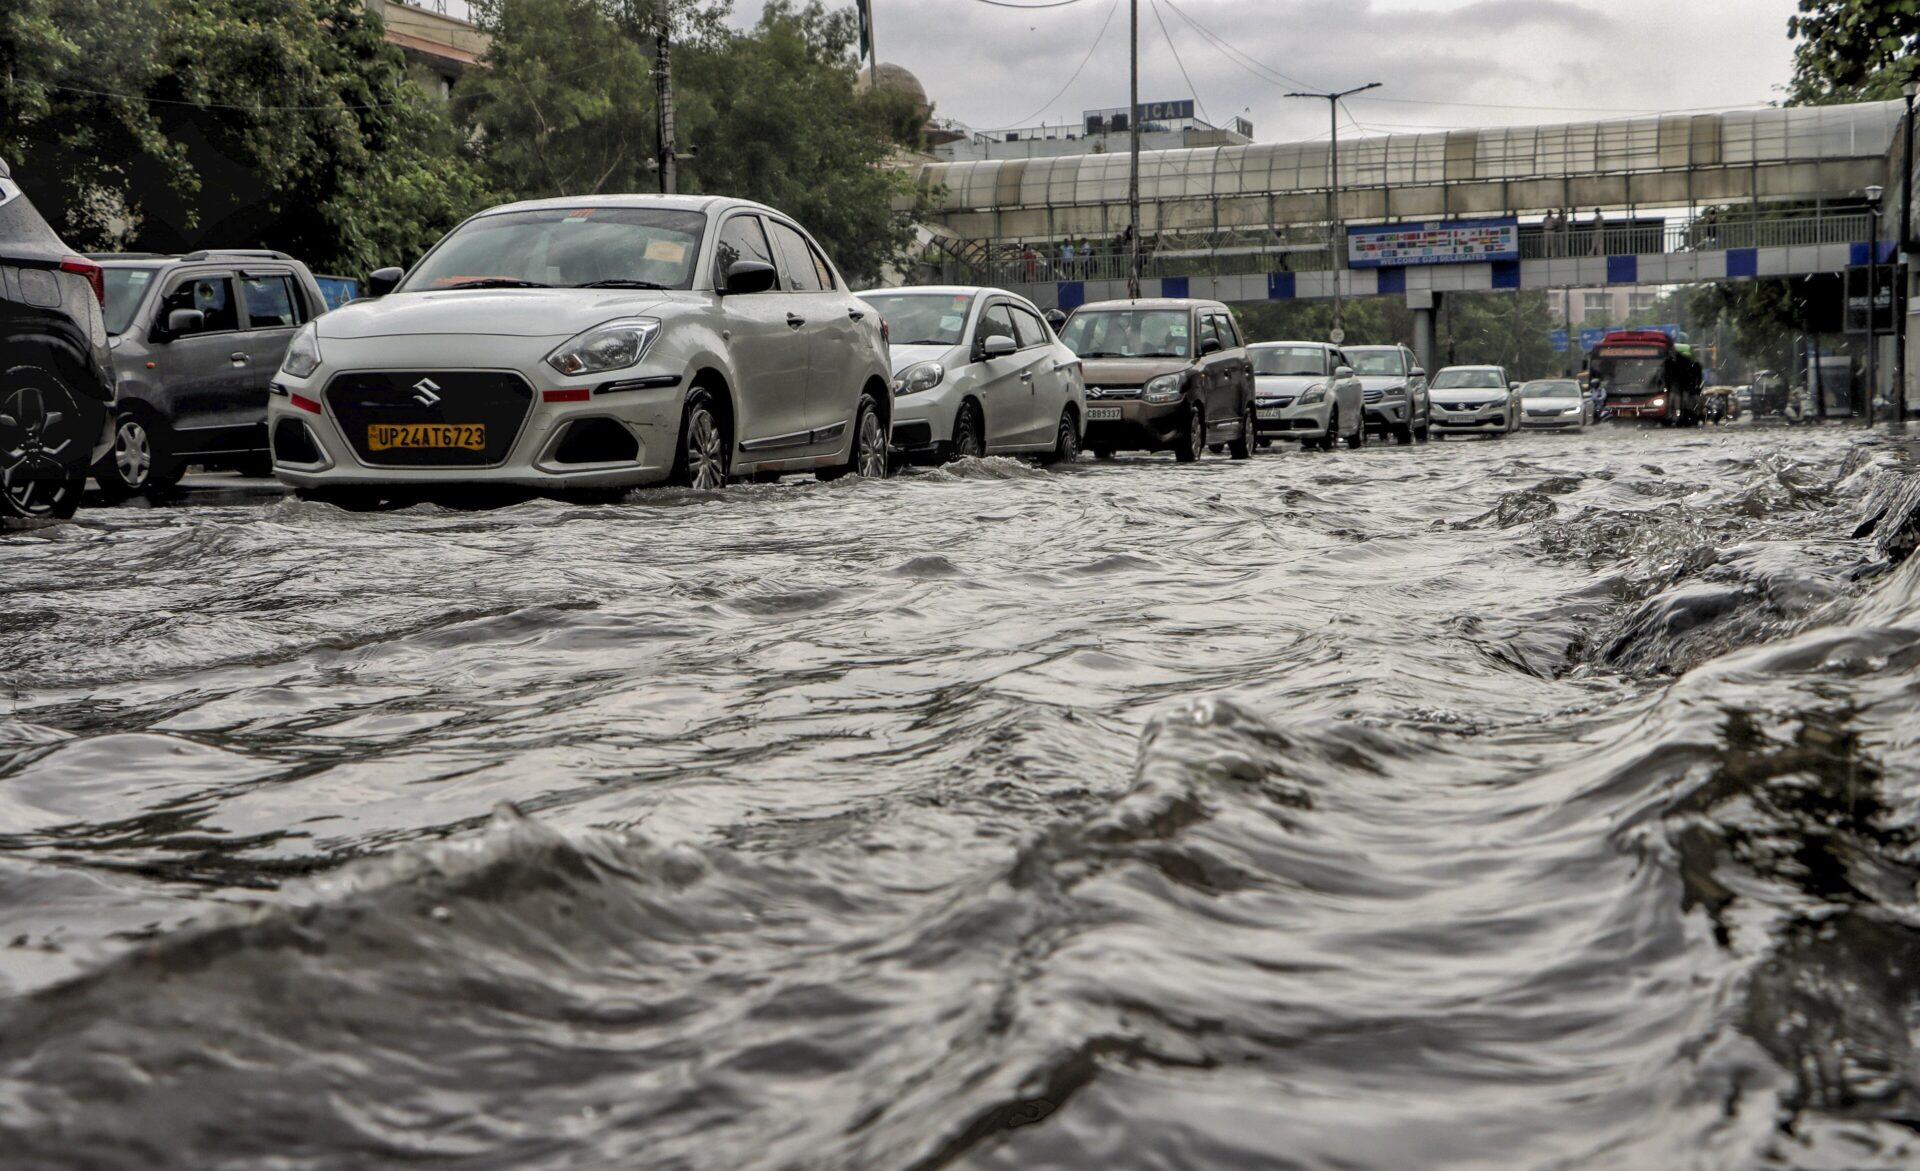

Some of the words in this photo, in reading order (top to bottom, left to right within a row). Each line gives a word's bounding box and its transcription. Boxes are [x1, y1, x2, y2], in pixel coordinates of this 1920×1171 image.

[1144, 102, 1184, 119] ICAI
[1380, 256, 1420, 265] WELCOME
[1422, 255, 1438, 264] G20
[1440, 253, 1487, 263] DELEGATES
[379, 427, 484, 446] UP24AT6723
